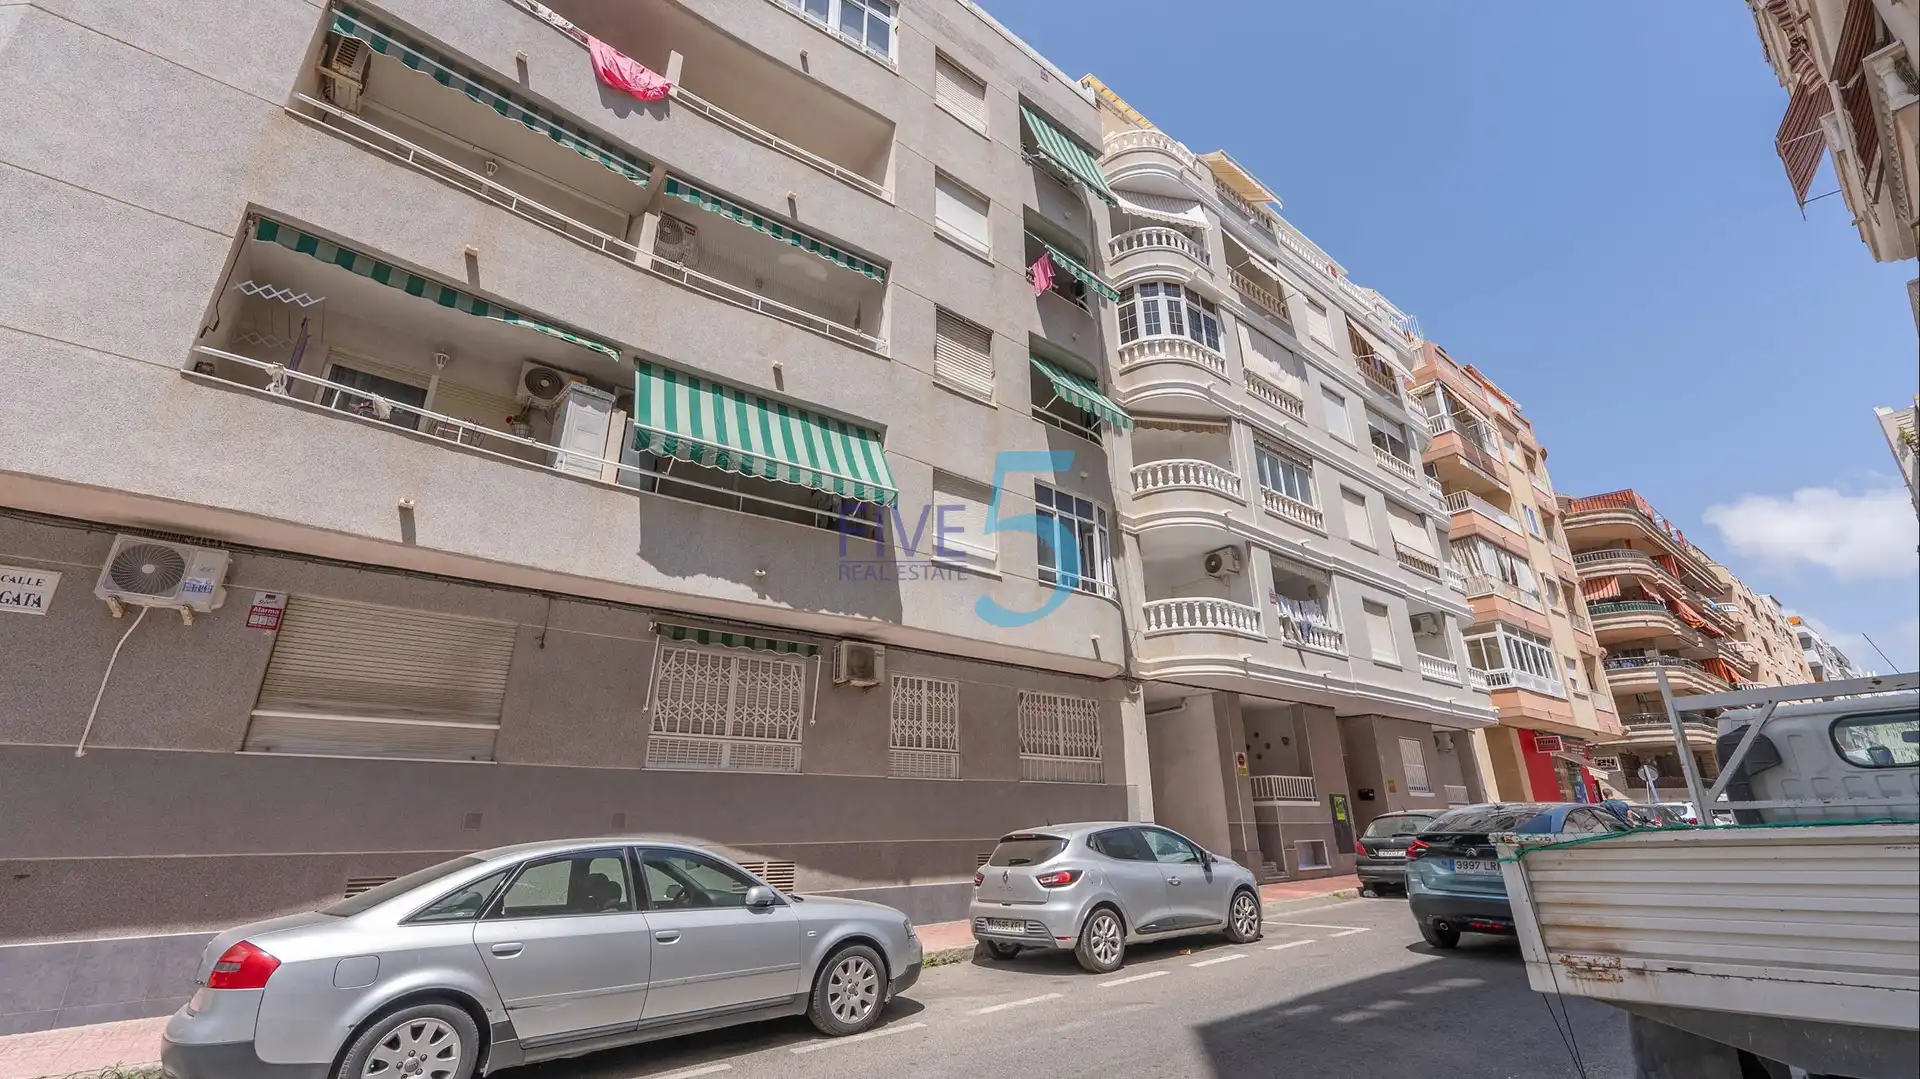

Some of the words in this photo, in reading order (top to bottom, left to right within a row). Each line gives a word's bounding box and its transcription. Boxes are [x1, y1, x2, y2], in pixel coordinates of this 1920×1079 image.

[0, 574, 45, 587] CALLE
[0, 590, 42, 608] GATA
[252, 606, 280, 615] Alarma
[1456, 861, 1480, 870] 9997
